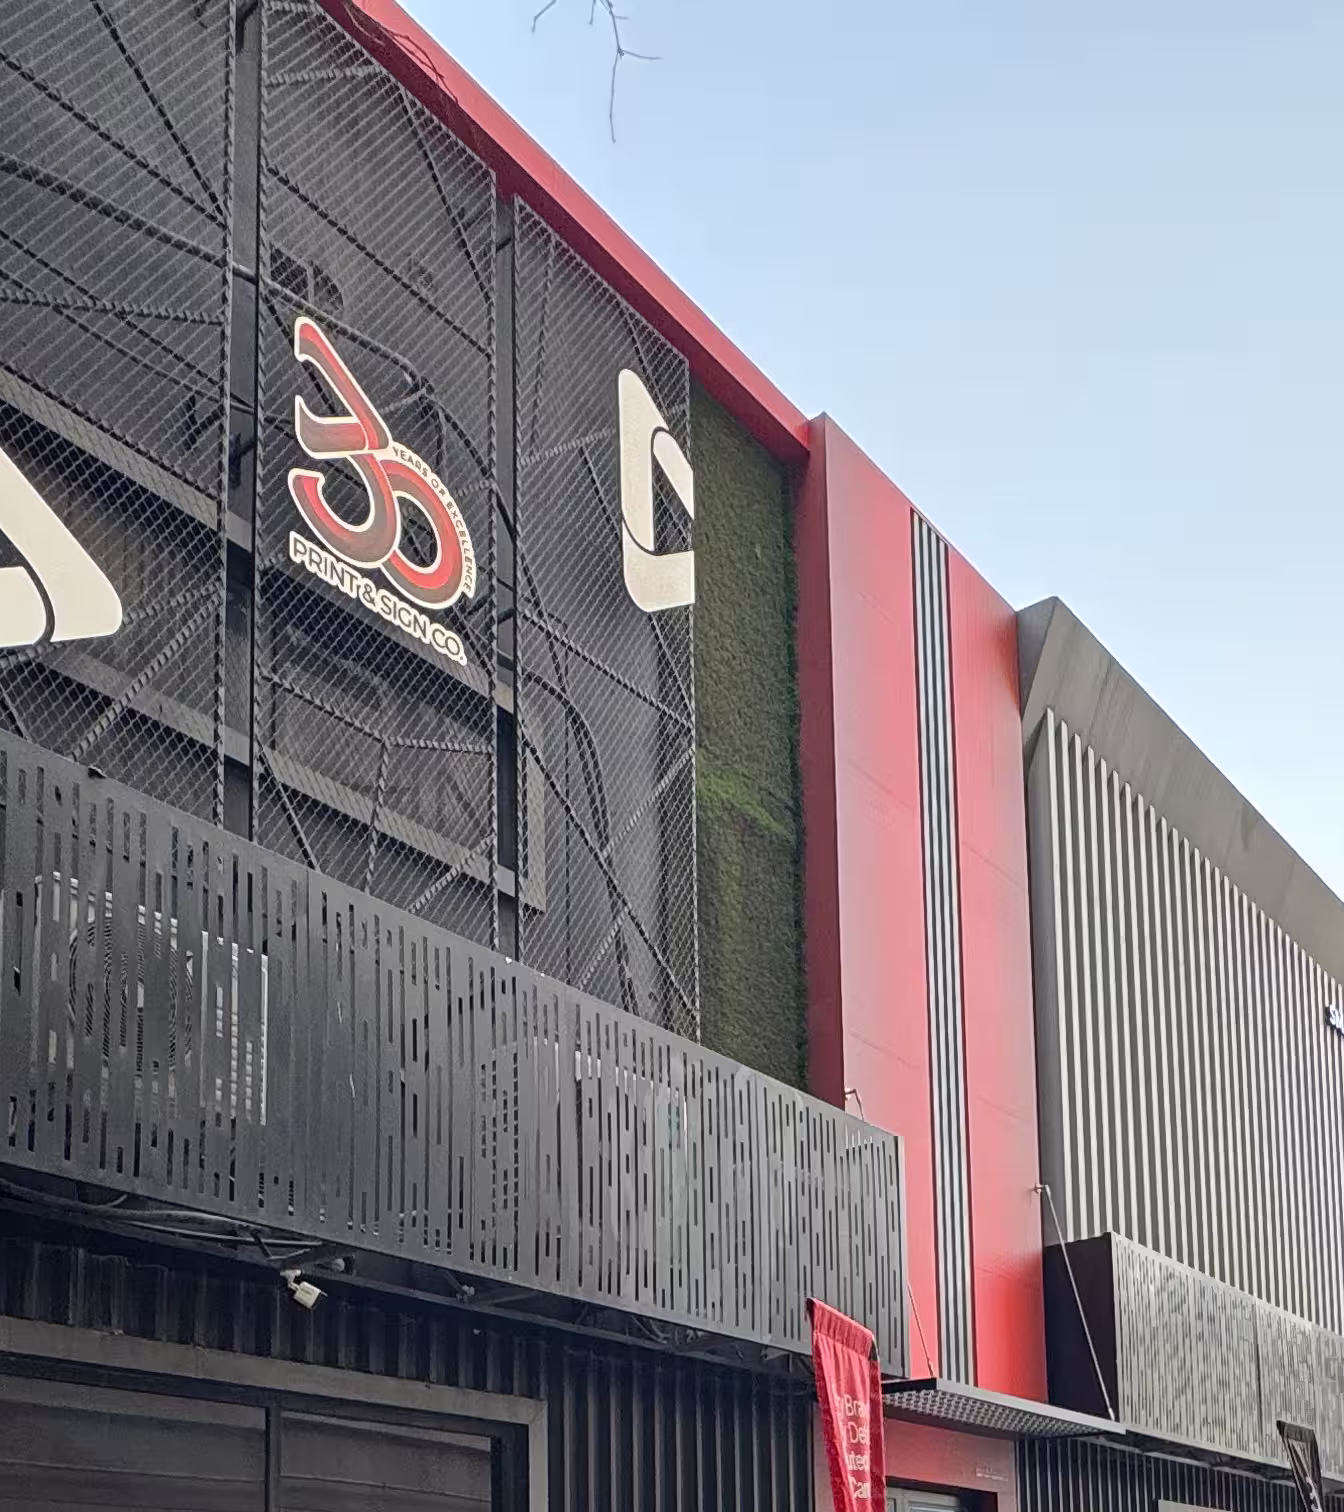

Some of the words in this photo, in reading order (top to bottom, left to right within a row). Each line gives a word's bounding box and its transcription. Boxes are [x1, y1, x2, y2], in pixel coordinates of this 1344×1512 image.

[392, 446, 428, 478] YEARS
[431, 478, 446, 497] OF
[446, 501, 474, 592] EXCELLENCE
[293, 538, 358, 593] PRINT
[362, 583, 376, 606] &
[380, 594, 427, 638] SIGN
[432, 628, 464, 661] CO.
